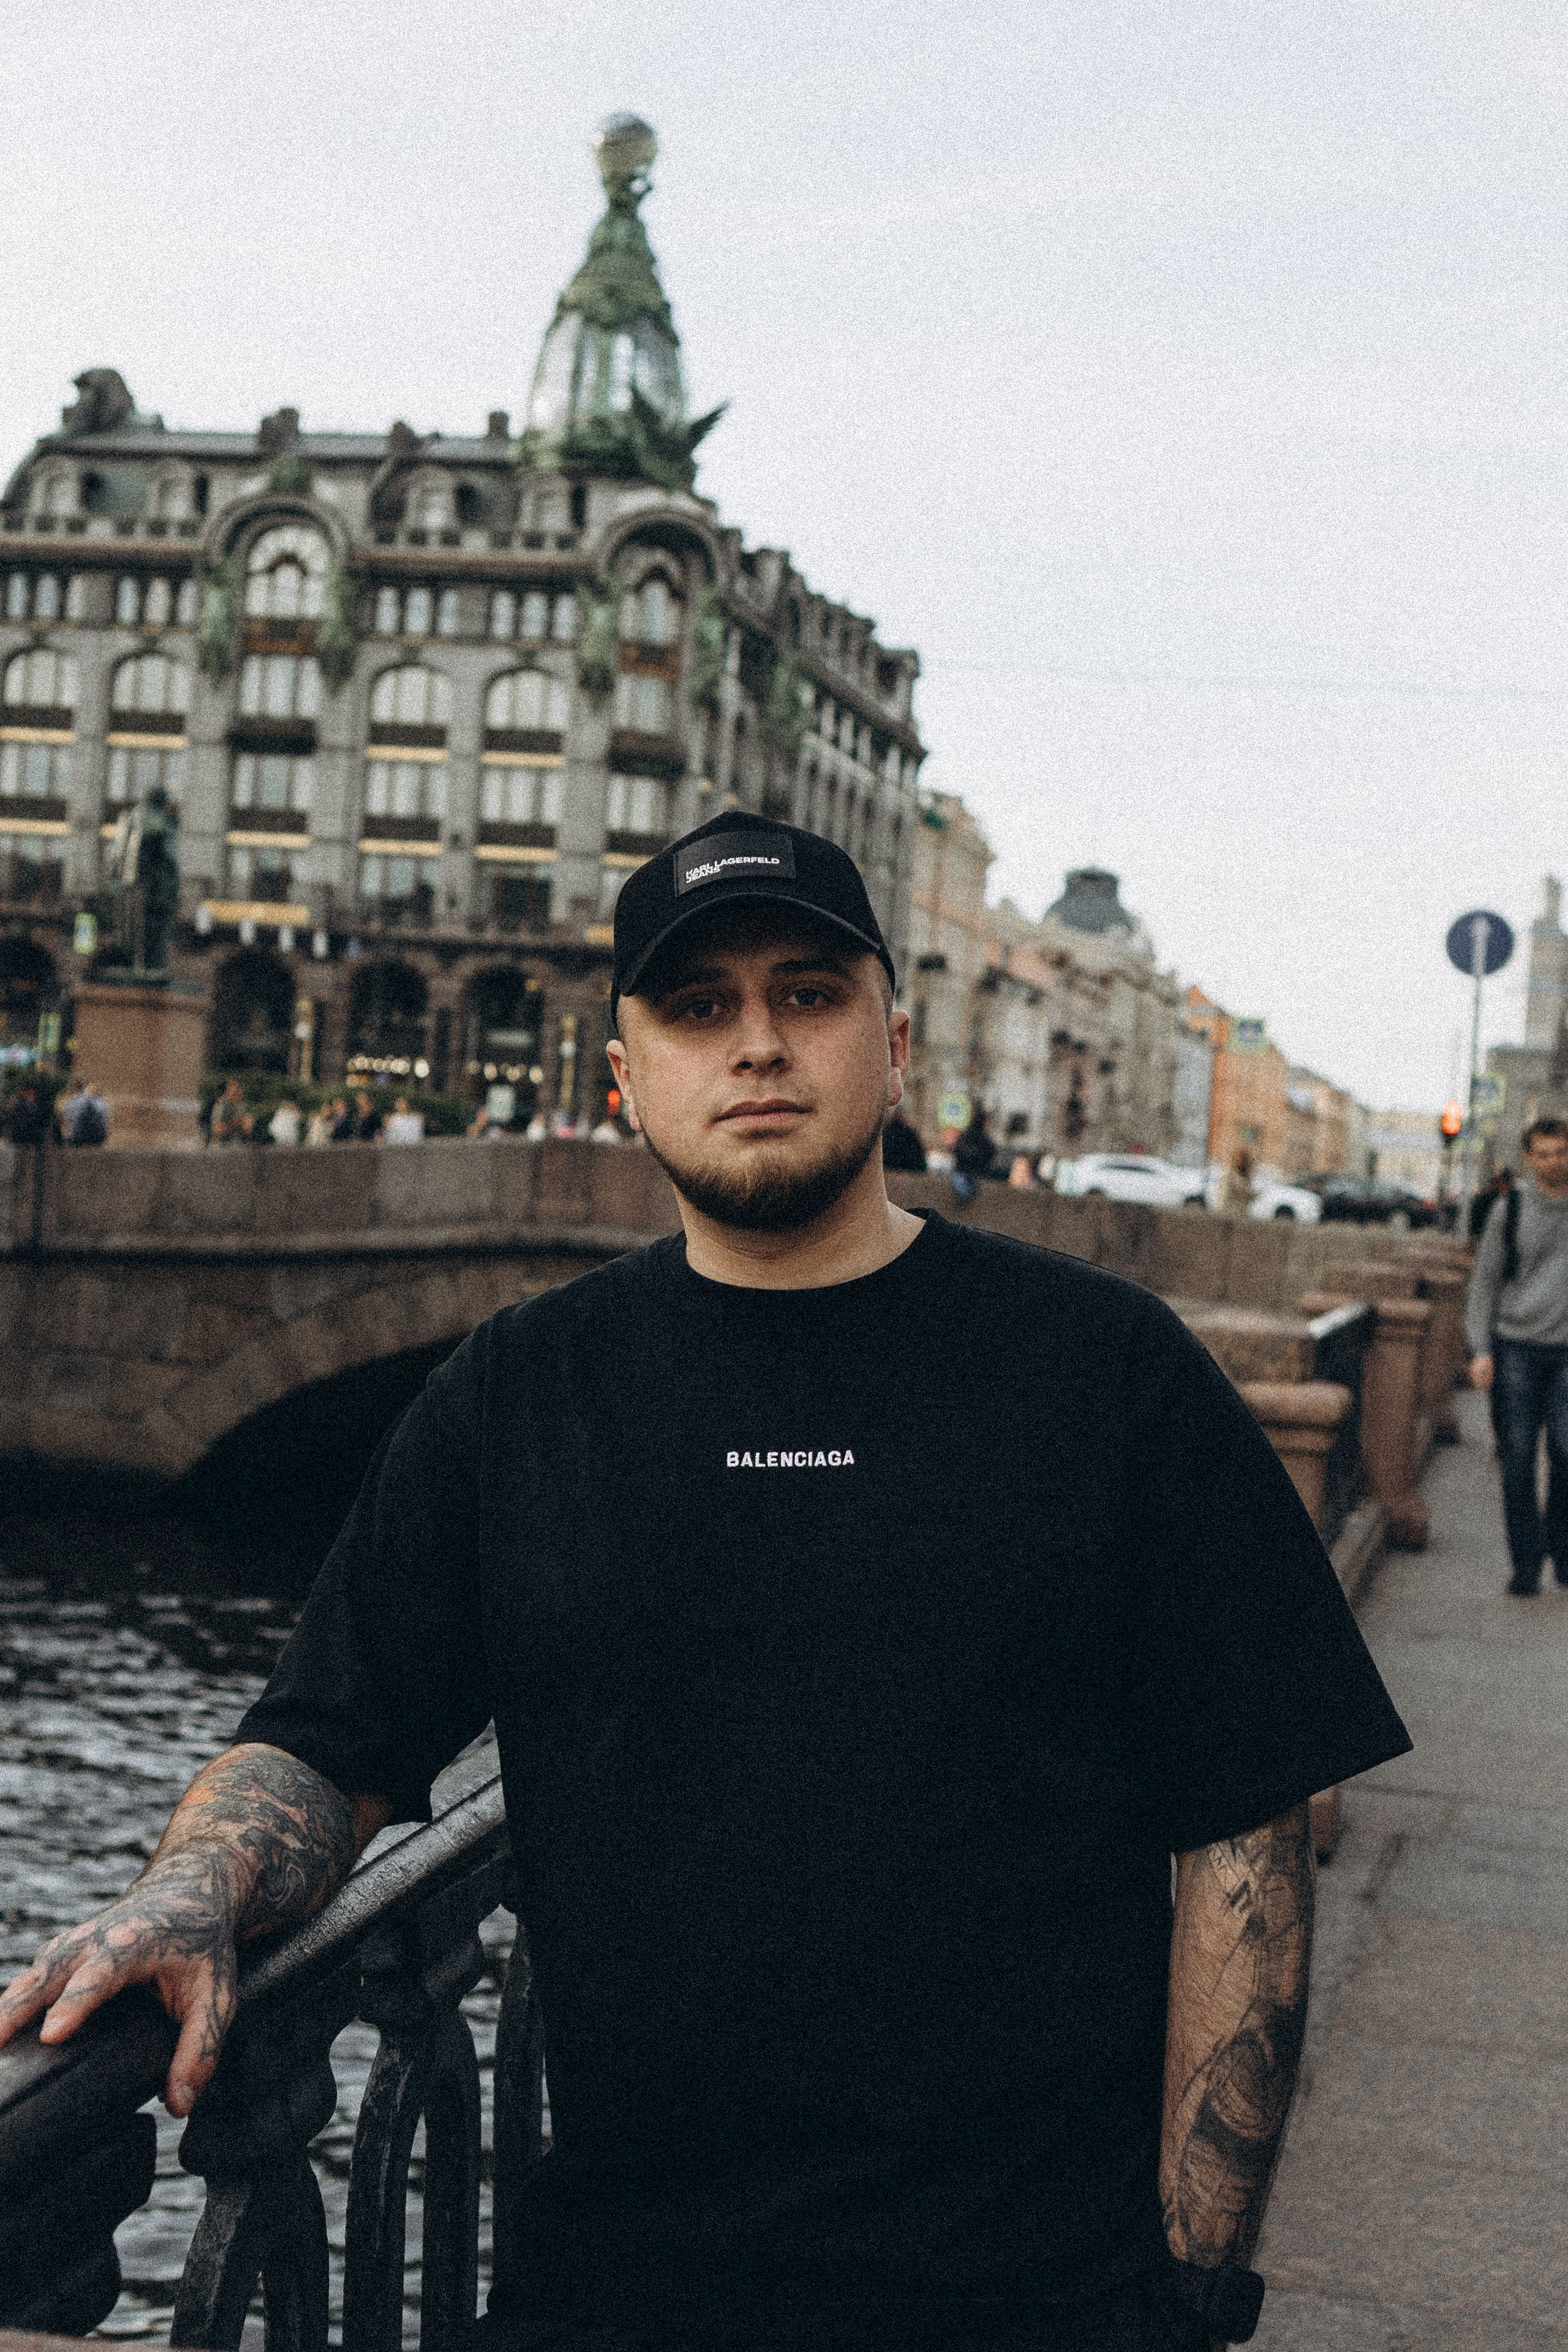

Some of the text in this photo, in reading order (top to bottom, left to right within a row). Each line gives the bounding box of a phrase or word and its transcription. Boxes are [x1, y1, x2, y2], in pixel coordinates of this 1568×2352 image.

[686, 857, 780, 878] KARL LAGERFELD
[686, 866, 721, 883] JEANS
[727, 1450, 855, 1468] BALENCIAGA
